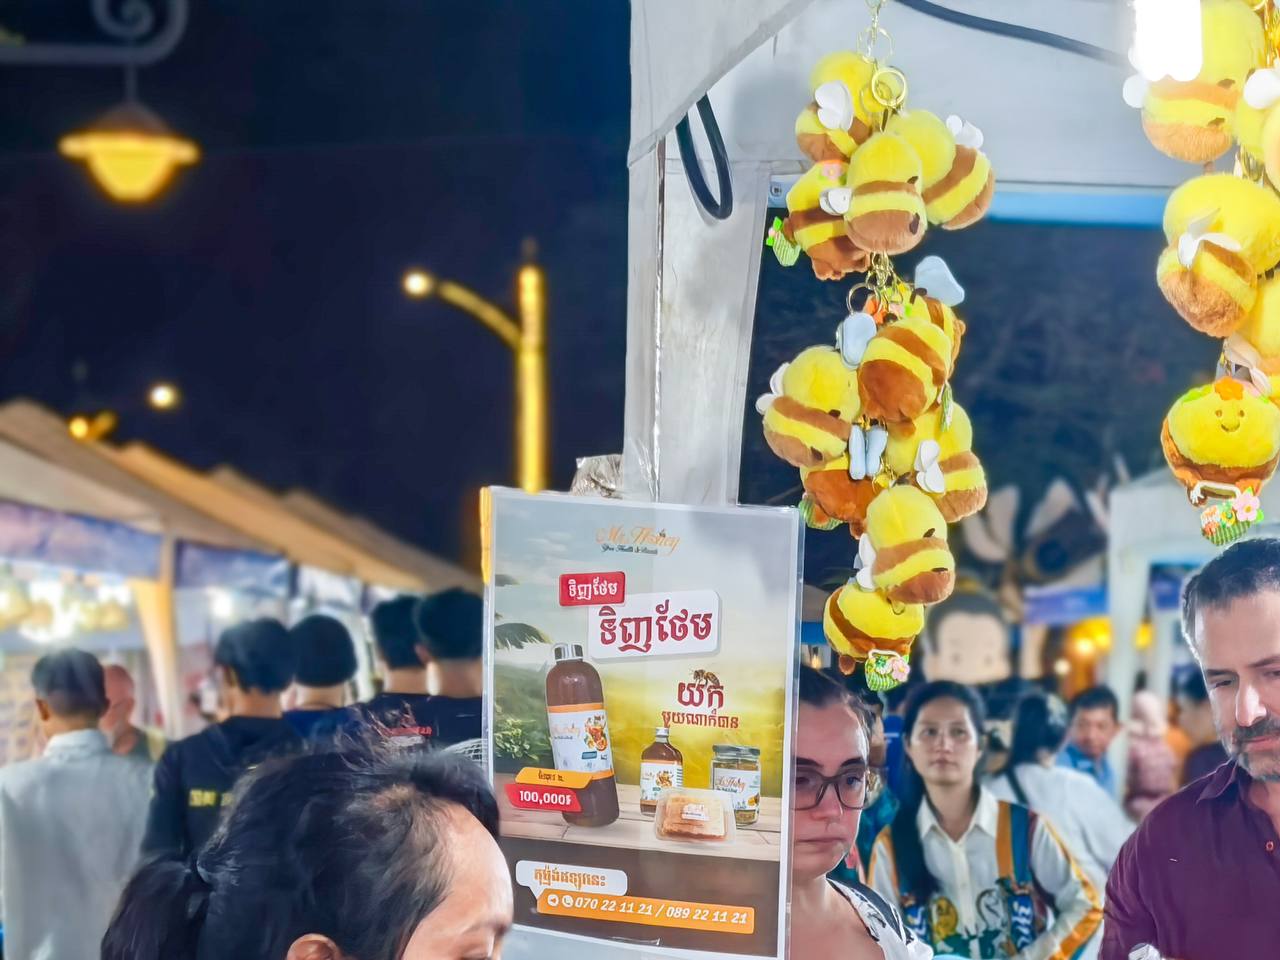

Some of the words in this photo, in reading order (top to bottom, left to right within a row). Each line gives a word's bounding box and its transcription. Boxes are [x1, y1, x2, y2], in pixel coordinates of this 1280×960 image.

[568, 577, 618, 600] ទិញថែម
[599, 599, 712, 653] ទិញថែម
[678, 682, 724, 708] យក
[575, 897, 598, 910] 070
[601, 900, 617, 911] 22
[619, 902, 635, 914] 11
[637, 904, 653, 916] 21
[666, 906, 689, 919] 089
[693, 909, 708, 921] 22
[712, 911, 727, 923] 11
[731, 912, 747, 925] 21
